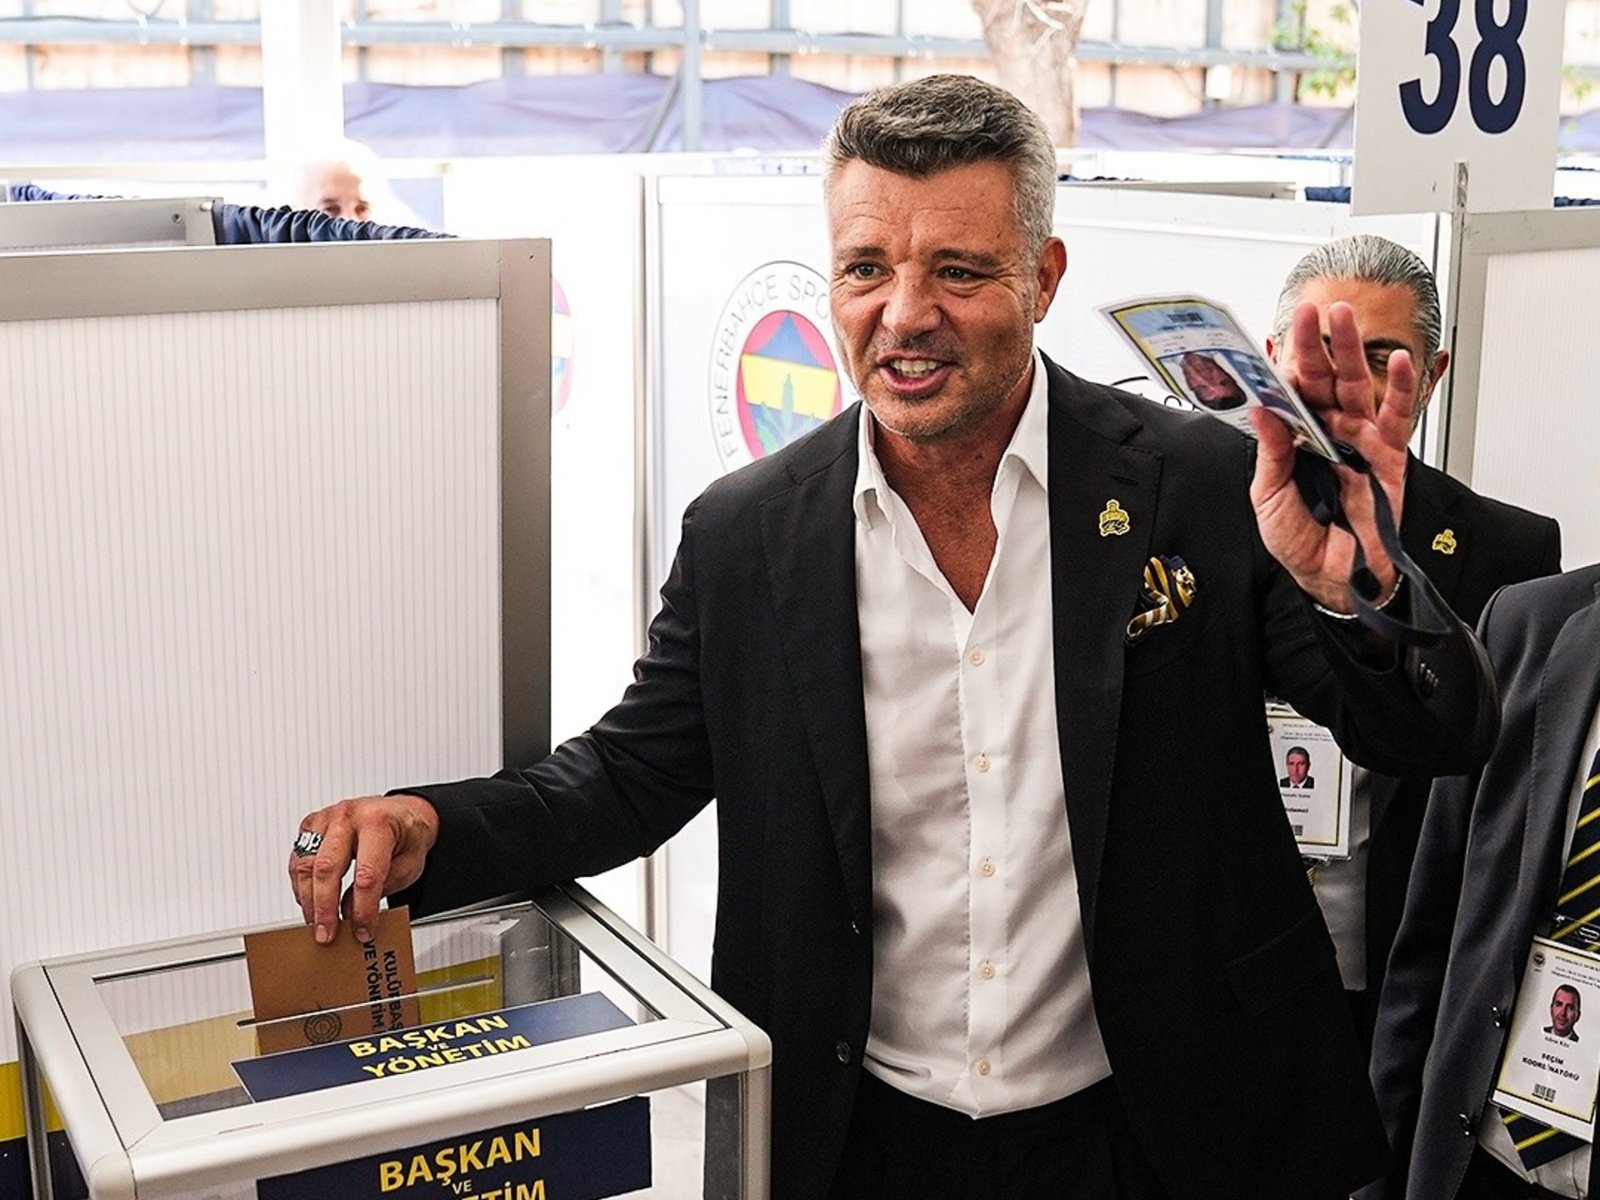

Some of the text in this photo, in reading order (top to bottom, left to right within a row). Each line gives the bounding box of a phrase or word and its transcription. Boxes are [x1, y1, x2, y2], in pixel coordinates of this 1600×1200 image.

[1399, 0, 1528, 135] 38
[713, 274, 779, 458] FENERBAHÇE
[363, 939, 377, 961] VE
[349, 1014, 509, 1058] BAŞKAN
[362, 1034, 532, 1079] YÖNETİM
[426, 1042, 450, 1053] VE
[379, 1128, 541, 1192] BAŞKAN
[452, 1179, 472, 1195] VE
